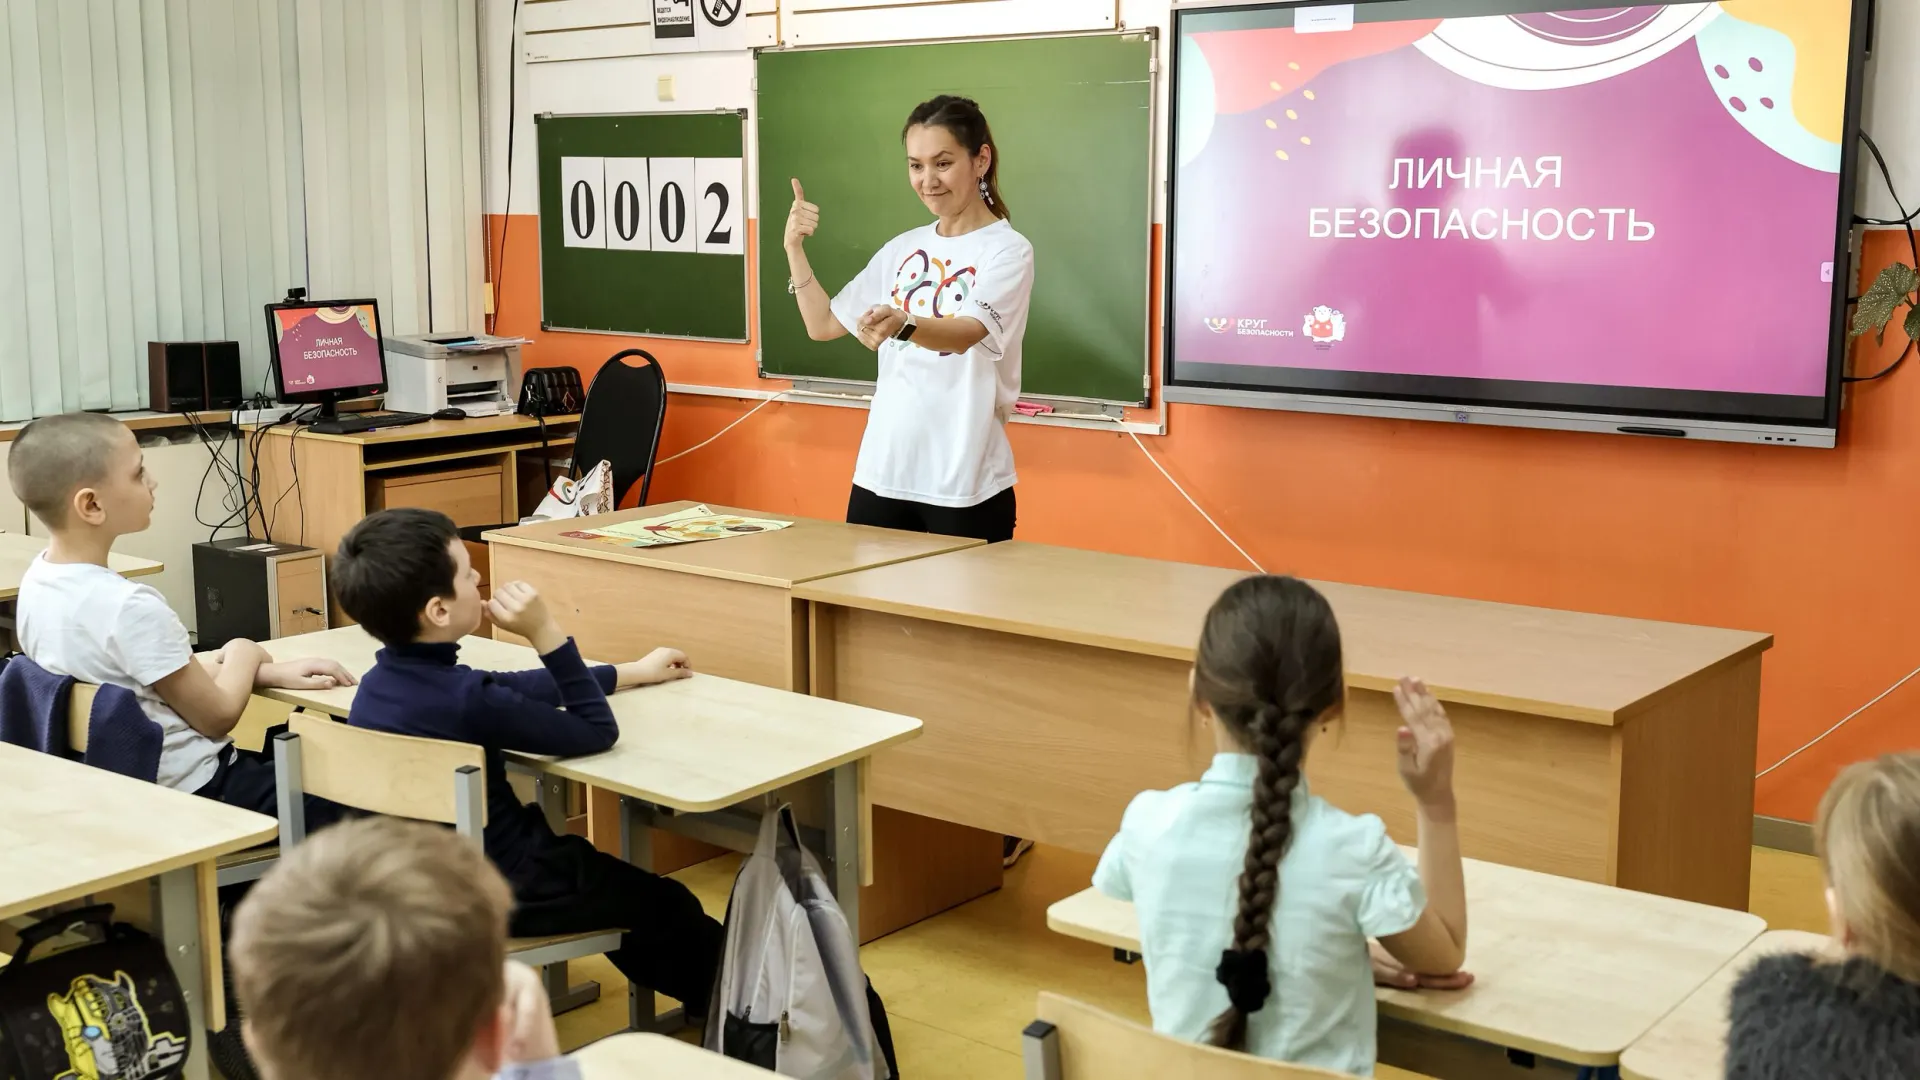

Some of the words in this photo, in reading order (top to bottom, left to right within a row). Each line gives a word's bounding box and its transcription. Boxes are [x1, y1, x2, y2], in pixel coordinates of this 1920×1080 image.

[1389, 155, 1562, 189] ЛИЧНАЯ
[1309, 207, 1656, 241] БЕЗОПАСНОСТЬ
[1237, 318, 1268, 329] КРУГ
[1237, 328, 1294, 338] БЕЗОПАСНОСТИ
[315, 337, 343, 347] ЛИЧНАЯ
[303, 347, 358, 360] БЕЗОПАСНОСТЬ
